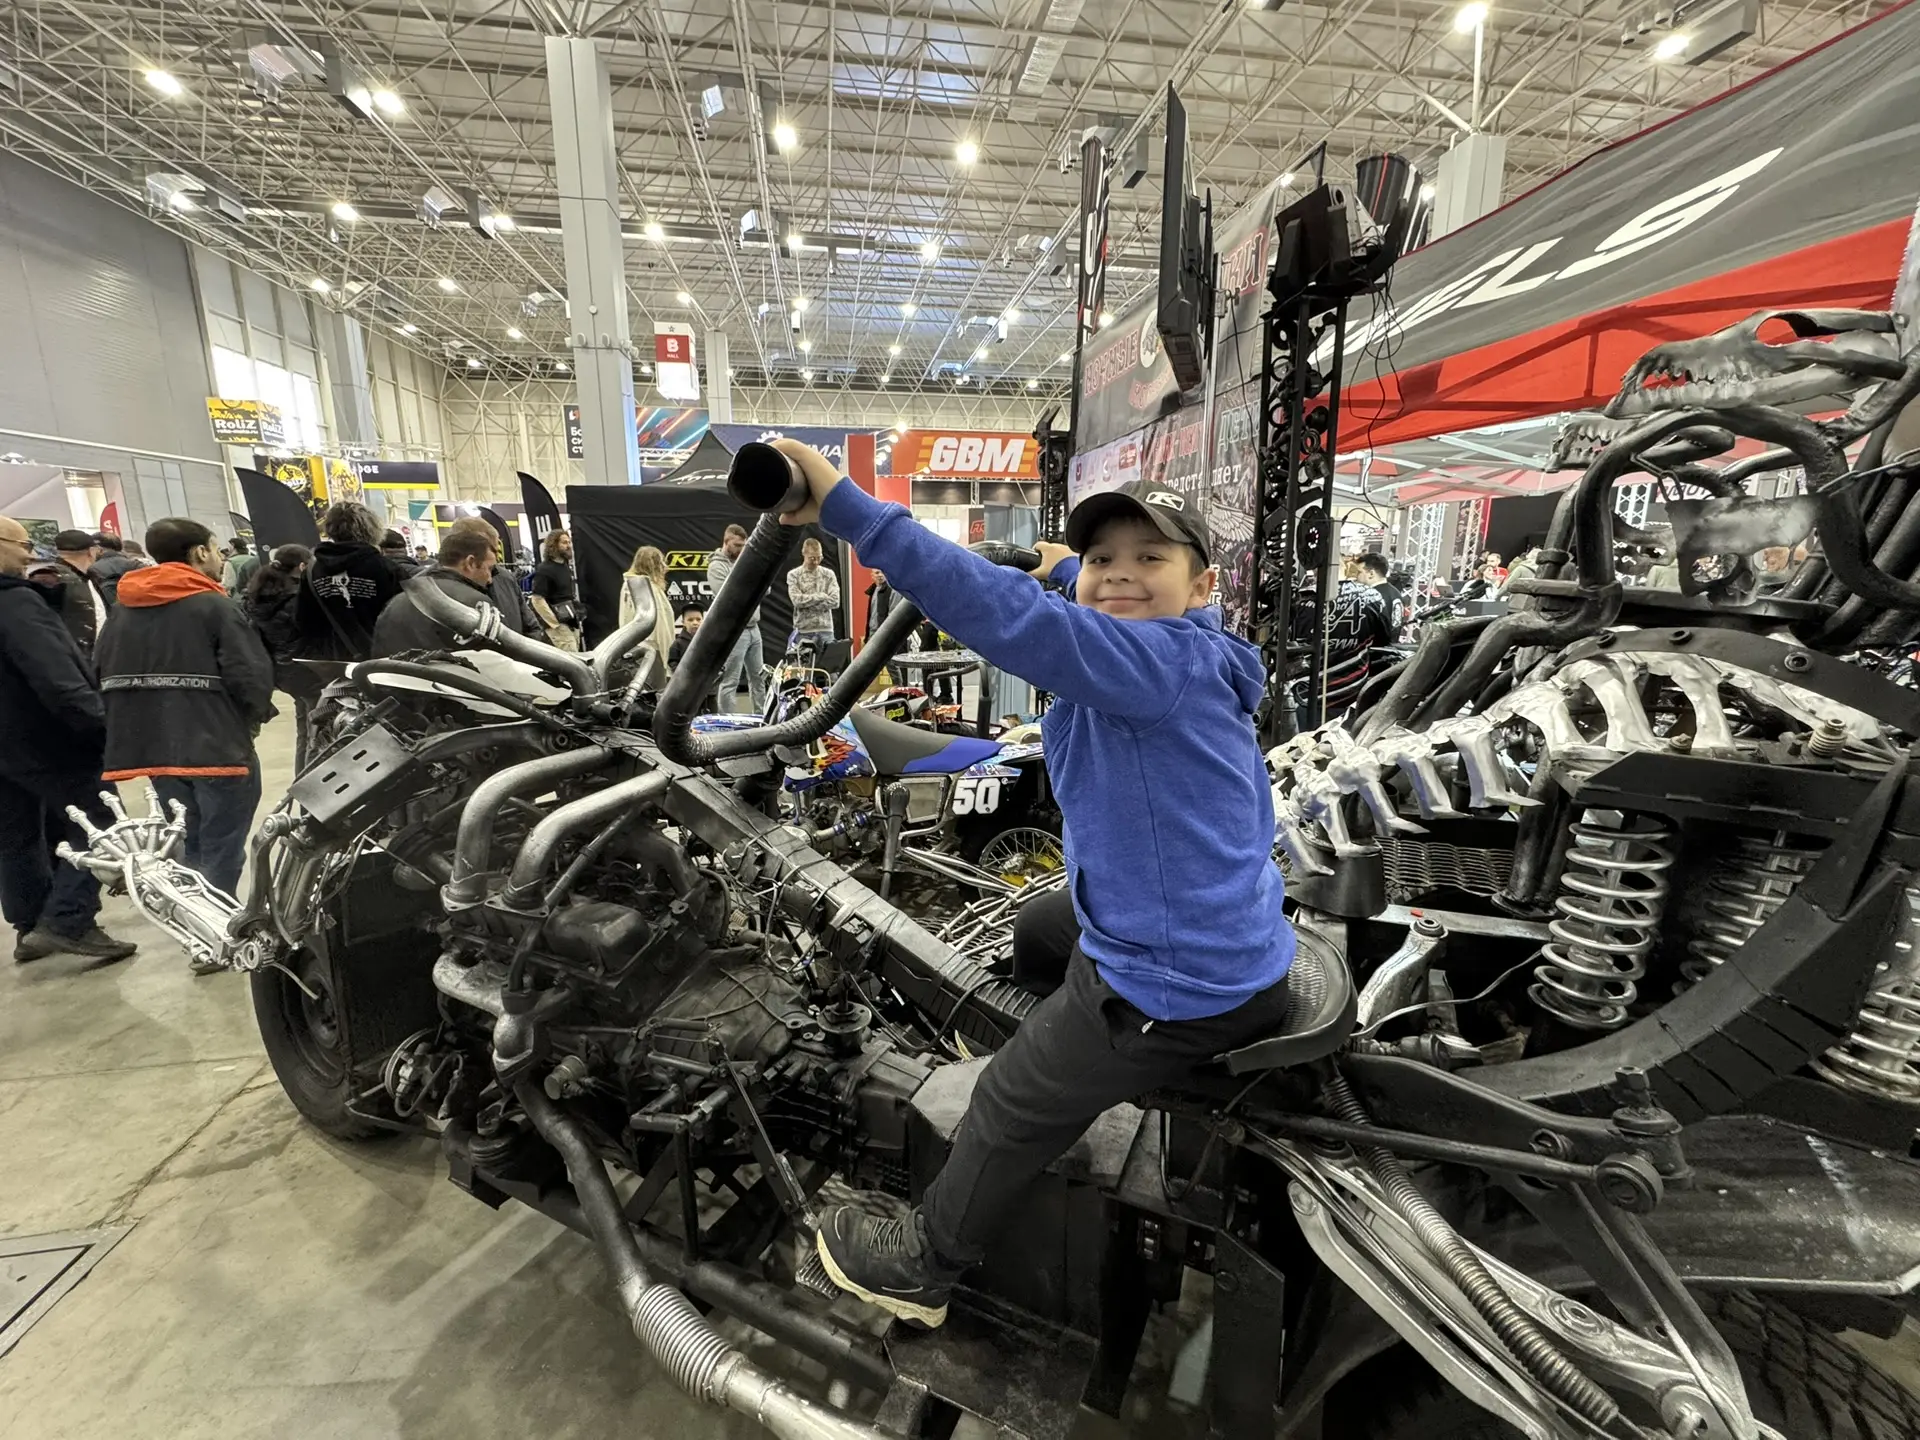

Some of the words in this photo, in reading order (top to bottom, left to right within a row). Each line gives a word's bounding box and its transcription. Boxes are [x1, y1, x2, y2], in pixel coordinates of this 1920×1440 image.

[666, 337, 679, 352] B
[929, 436, 1026, 473] GBM
[952, 778, 1001, 815] 50
